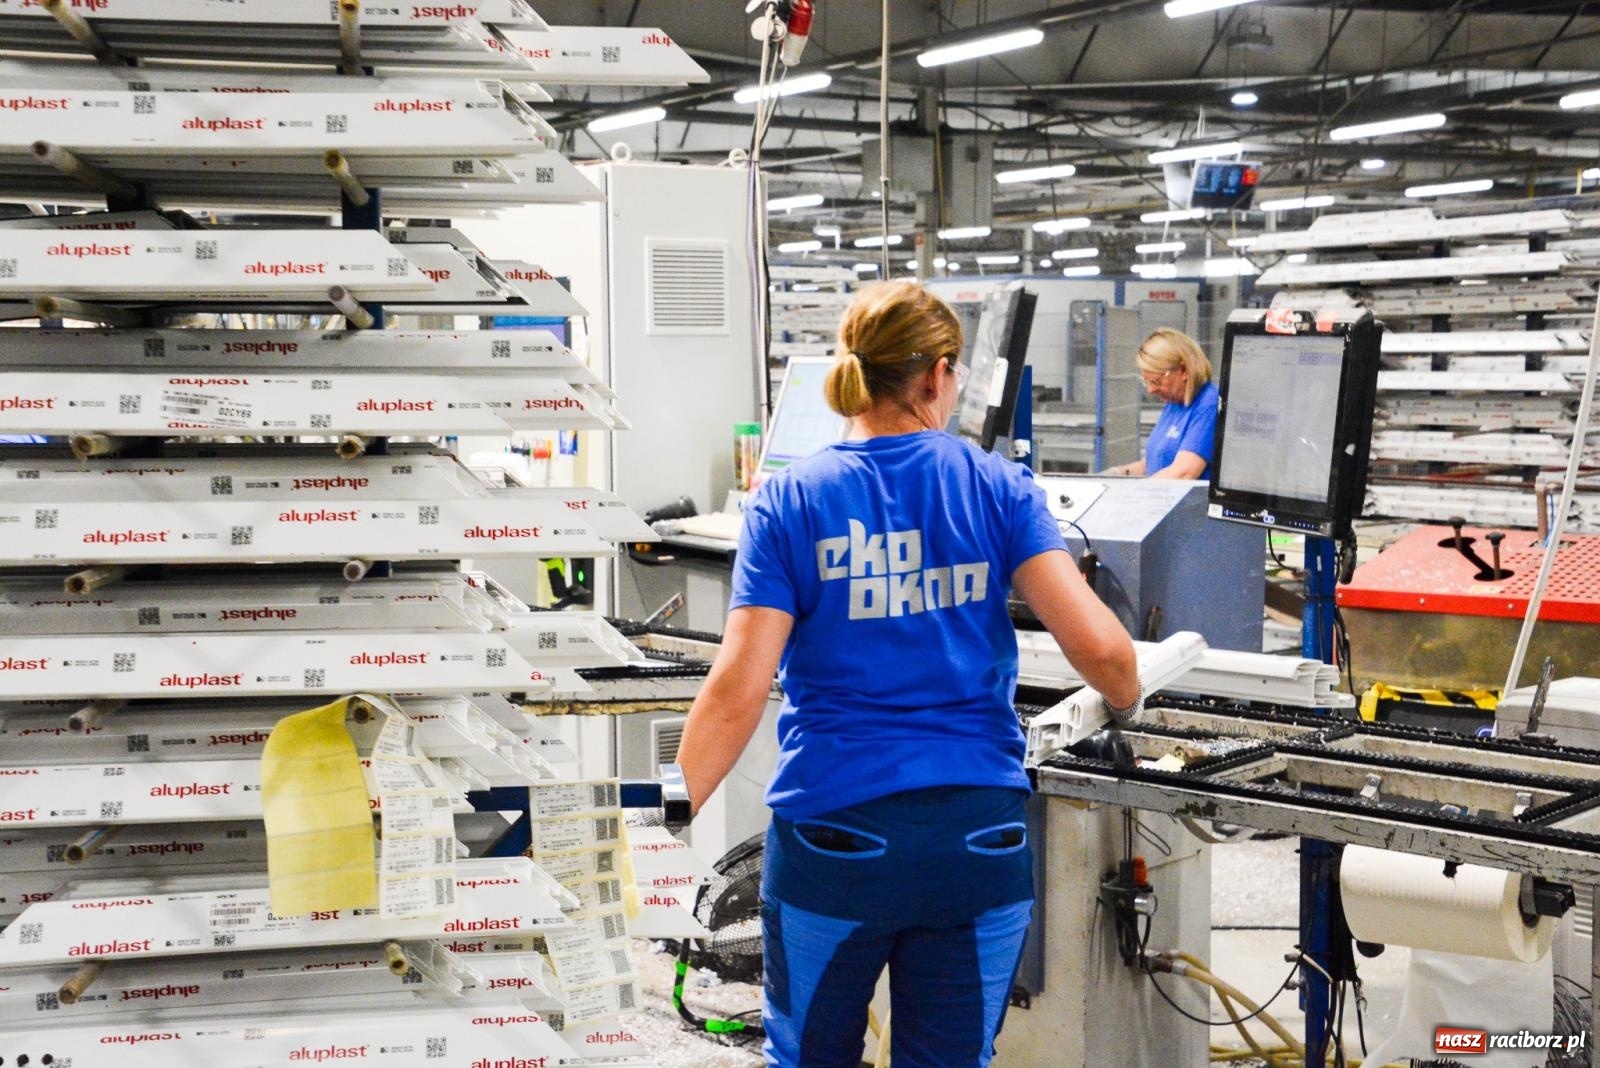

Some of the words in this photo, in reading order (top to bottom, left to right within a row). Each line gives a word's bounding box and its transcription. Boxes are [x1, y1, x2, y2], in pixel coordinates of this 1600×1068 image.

[374, 99, 453, 114] aluplast
[181, 117, 264, 132] aluplast
[47, 243, 131, 259] aluplast
[243, 261, 325, 277] aluplast
[224, 342, 298, 356] aluplast
[356, 399, 433, 414] aluplast
[294, 476, 369, 490] aluplast
[278, 508, 357, 525] aluplast
[83, 529, 168, 545] aluplast
[464, 525, 540, 541] aluplast
[815, 518, 923, 581] eko
[848, 561, 990, 621] okna
[222, 607, 297, 621] aluplast
[350, 652, 428, 668] aluplast
[159, 673, 241, 689] aluplast
[150, 783, 230, 799] aluplast
[130, 842, 205, 856] aluplast
[444, 916, 520, 933] aluplast
[68, 938, 152, 957] aluplast
[121, 985, 200, 1001] aluplast
[289, 1045, 367, 1062] aluplast
